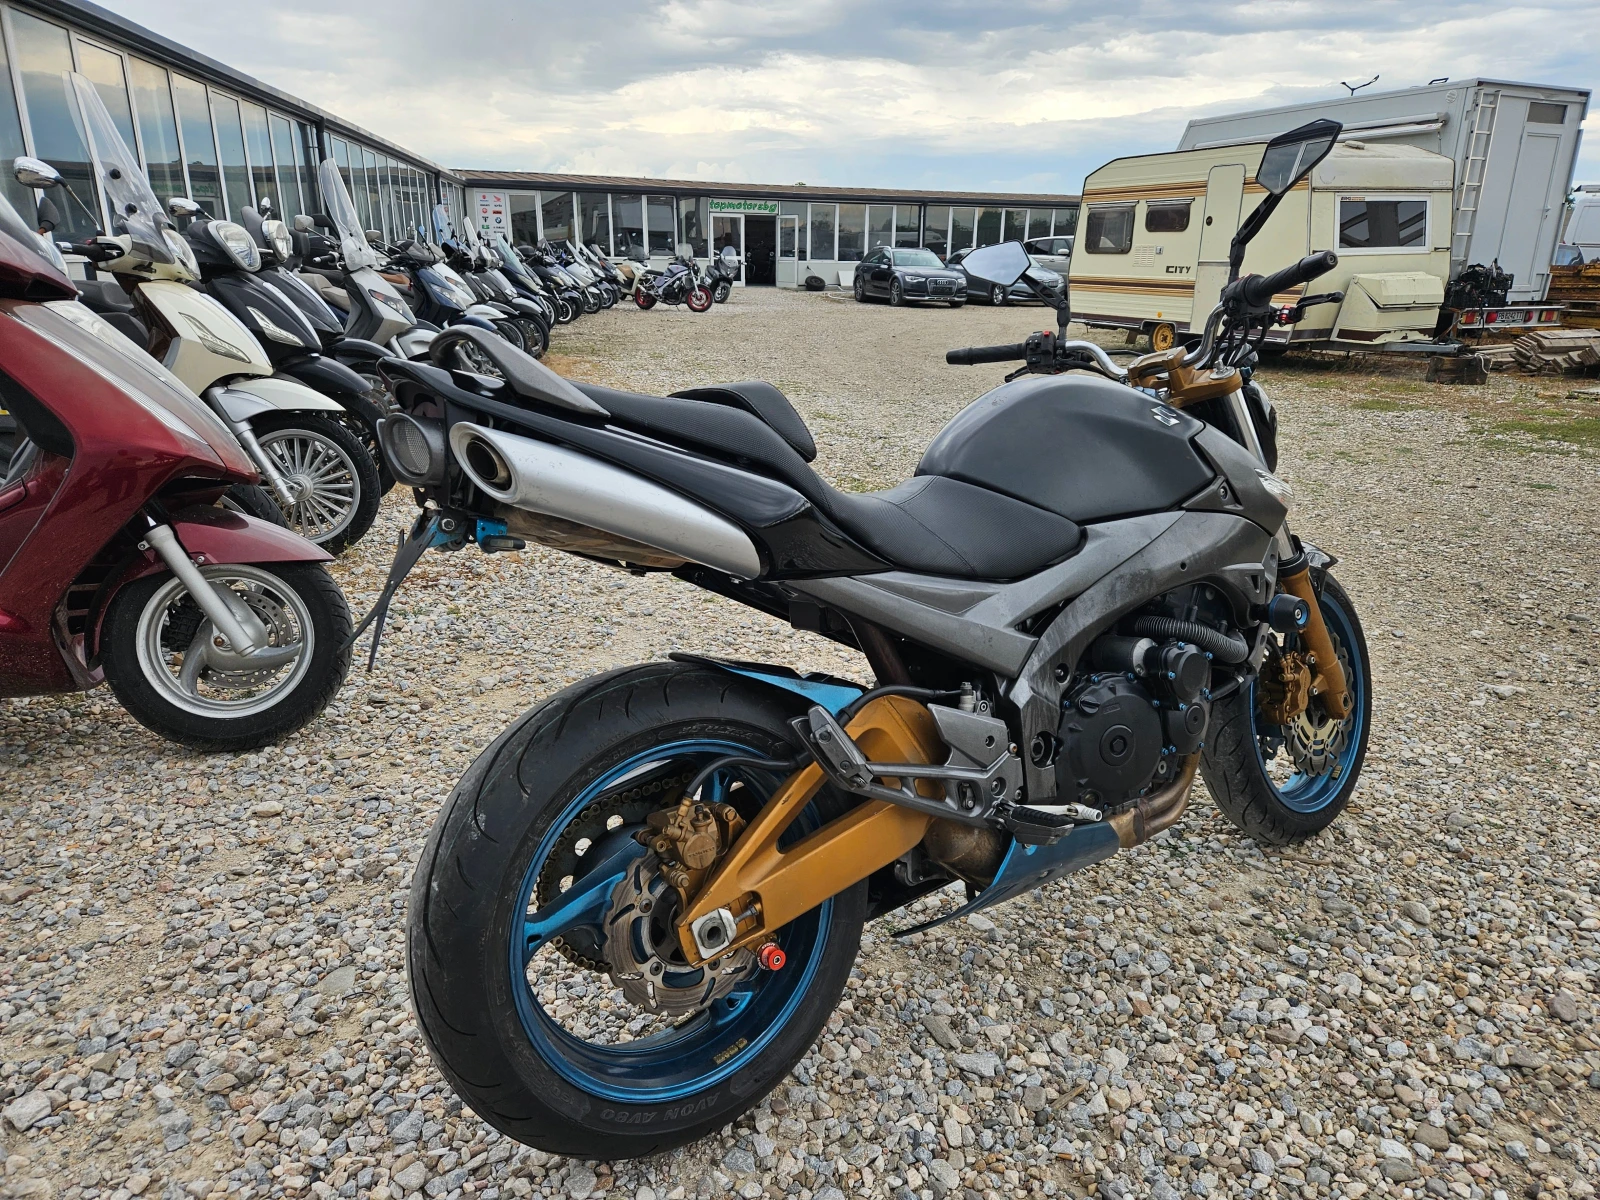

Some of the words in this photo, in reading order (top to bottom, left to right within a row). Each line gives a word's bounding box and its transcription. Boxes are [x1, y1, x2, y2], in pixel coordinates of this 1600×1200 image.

[709, 199, 777, 213] topmotorsbg
[1166, 265, 1191, 273] CITY
[663, 1092, 720, 1121] AVON
[600, 1108, 658, 1124] AV80
